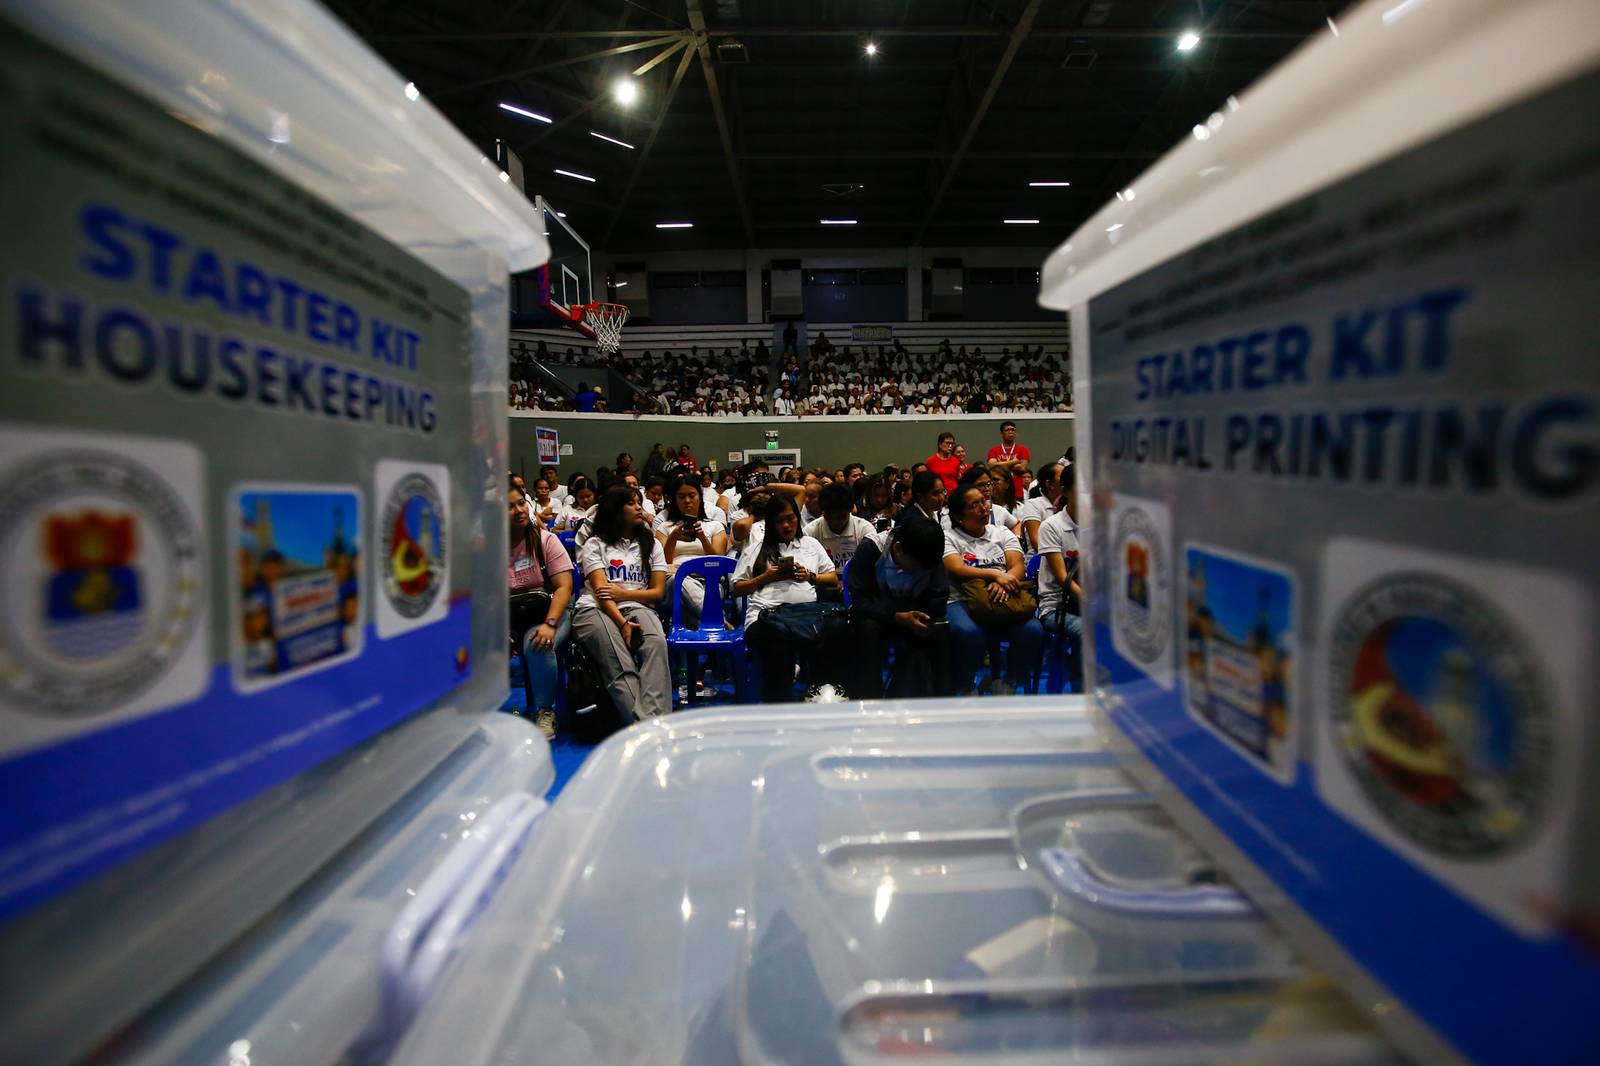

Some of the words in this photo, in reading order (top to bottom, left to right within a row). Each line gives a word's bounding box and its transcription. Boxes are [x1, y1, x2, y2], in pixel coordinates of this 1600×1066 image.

[80, 202, 362, 353] STARTER
[371, 318, 422, 372] KIT
[1134, 323, 1311, 402] STARTER
[1327, 285, 1473, 381] KIT
[15, 283, 438, 434] HOUSEKEEPING
[1109, 414, 1211, 470] DIGITAL
[1225, 394, 1600, 500] PRINTING
